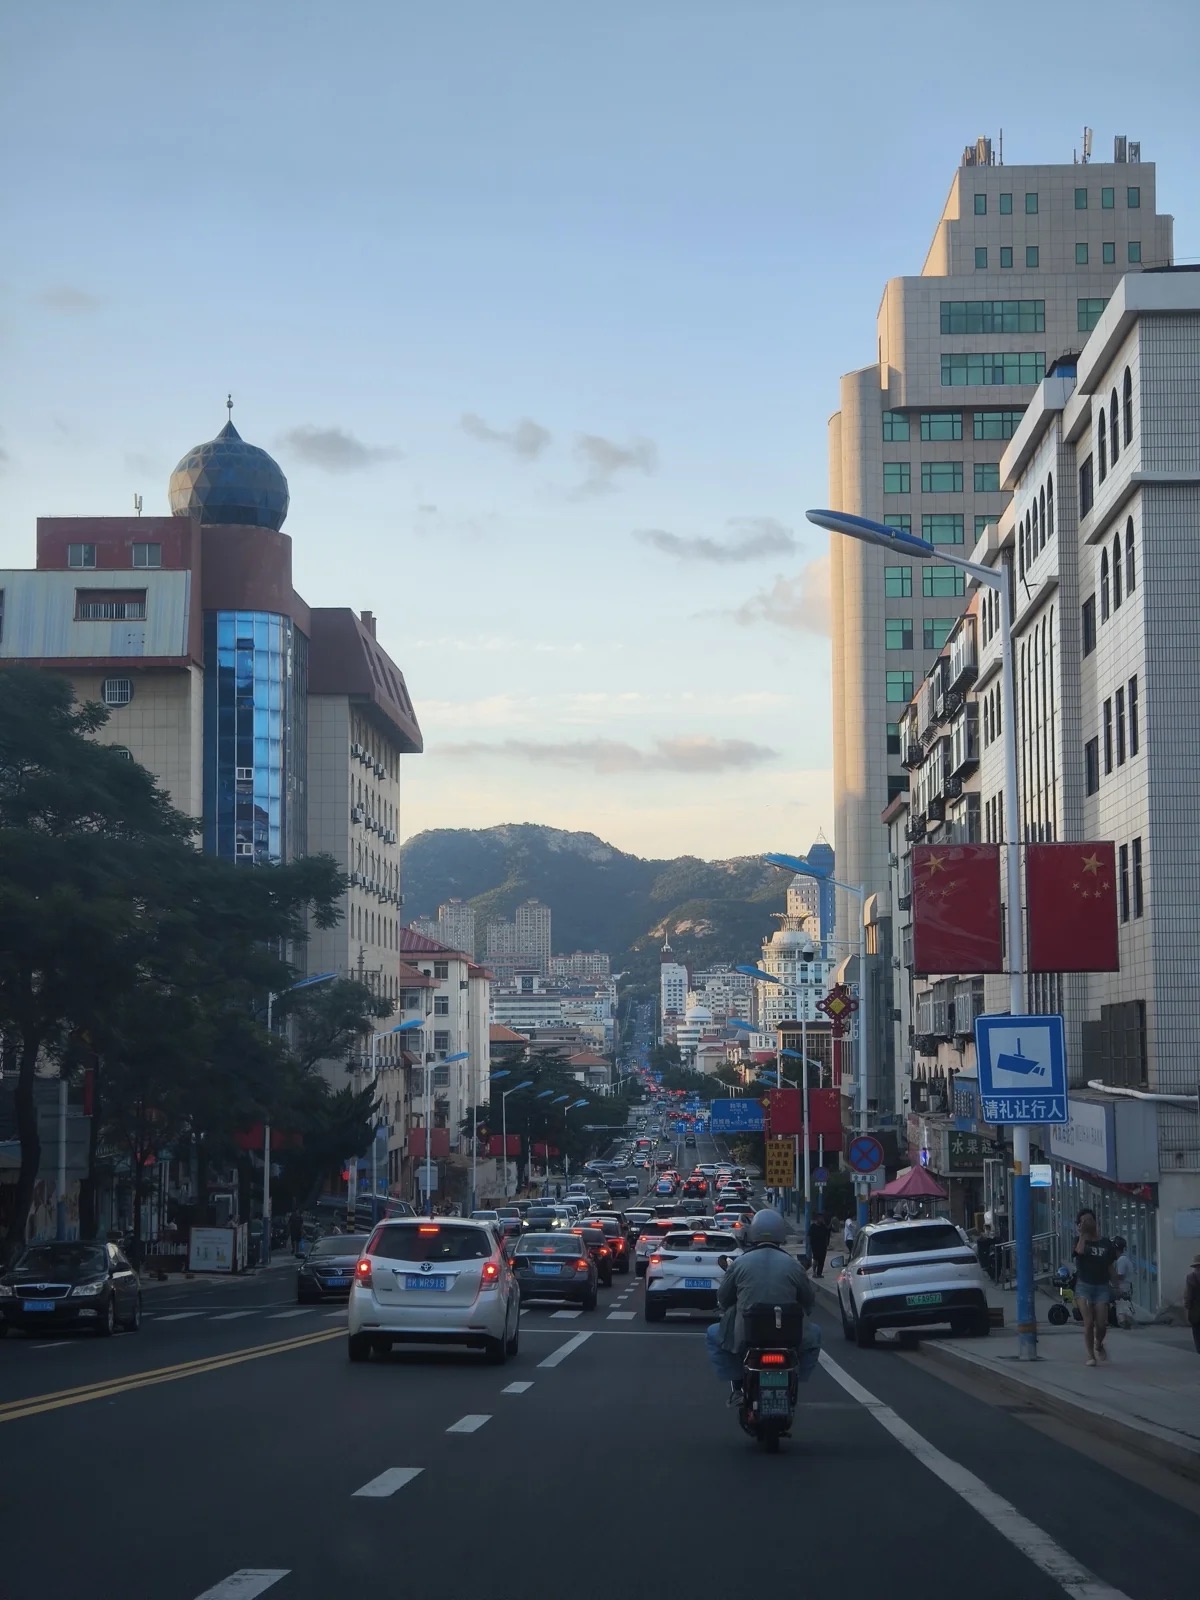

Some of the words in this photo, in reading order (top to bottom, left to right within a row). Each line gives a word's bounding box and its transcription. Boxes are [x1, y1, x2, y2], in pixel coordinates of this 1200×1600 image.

[985, 1099, 1063, 1119] 请礼让行人
